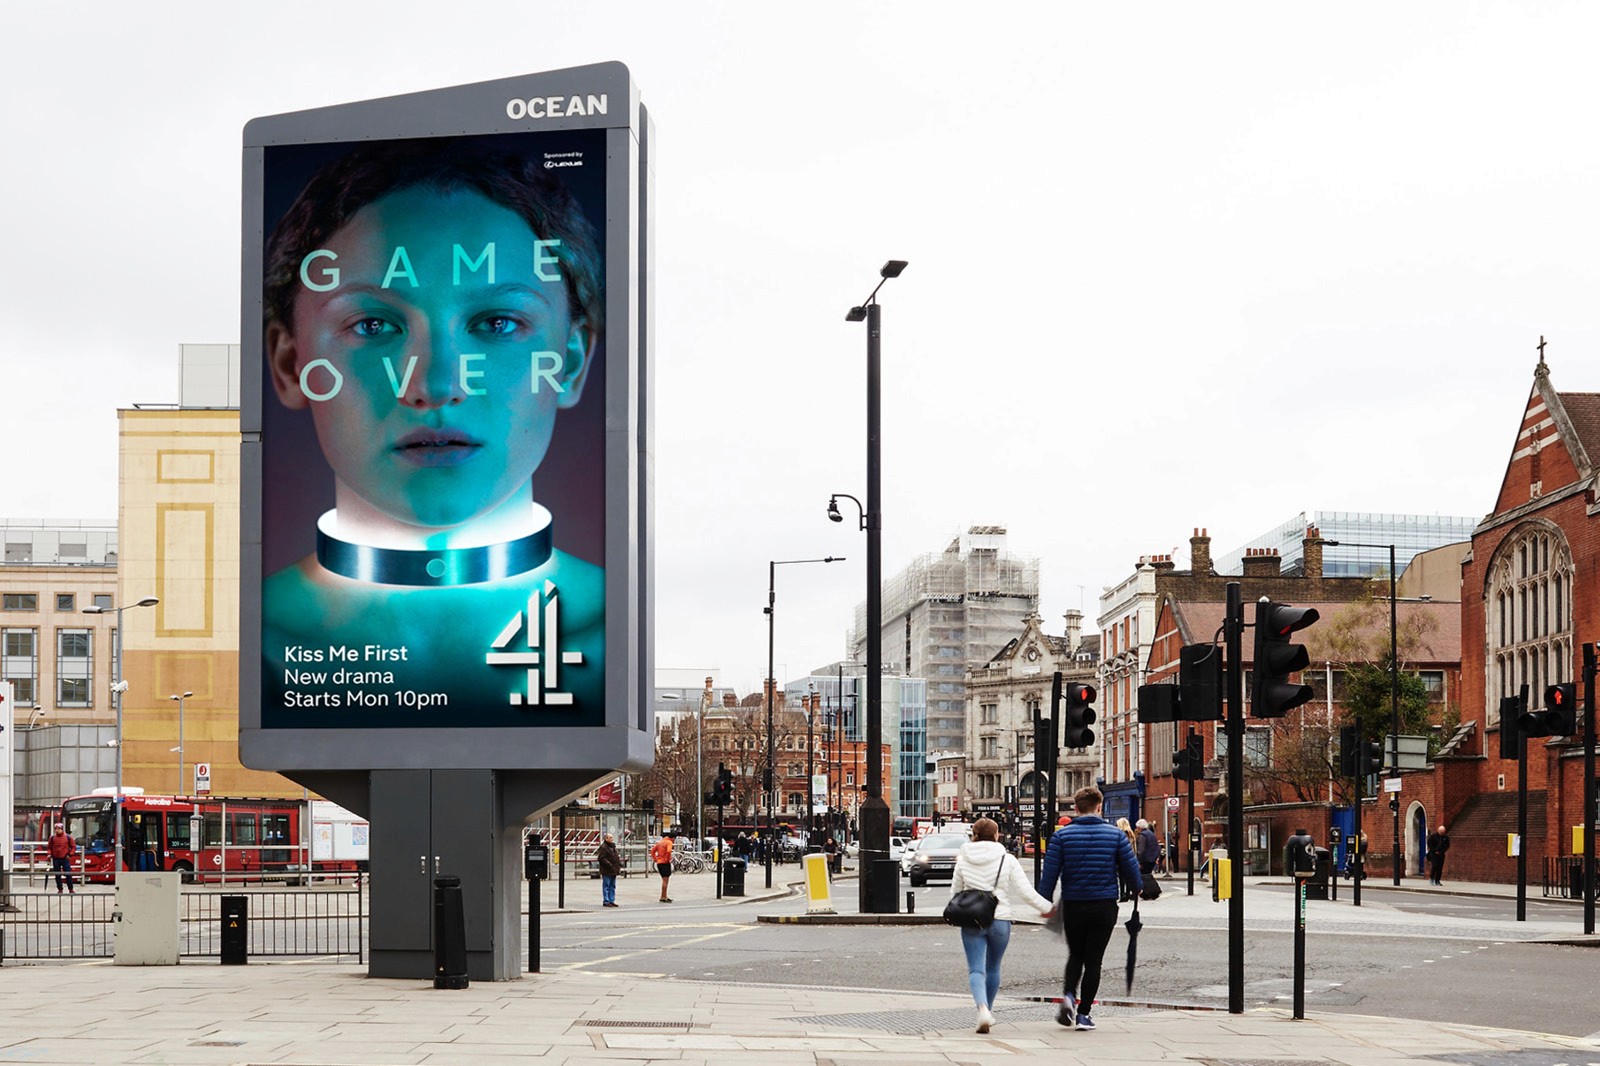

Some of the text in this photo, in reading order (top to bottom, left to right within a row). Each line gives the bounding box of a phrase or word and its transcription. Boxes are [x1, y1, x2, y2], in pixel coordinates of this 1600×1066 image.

[506, 94, 607, 119] OCEAN
[300, 239, 561, 292] GAME
[299, 351, 566, 402] OVER
[486, 578, 583, 705] 4
[284, 645, 408, 662] Kiss Me First
[284, 668, 394, 685] New drama
[284, 690, 448, 710] Starts Mon 10pm
[145, 798, 171, 806] Metroline
